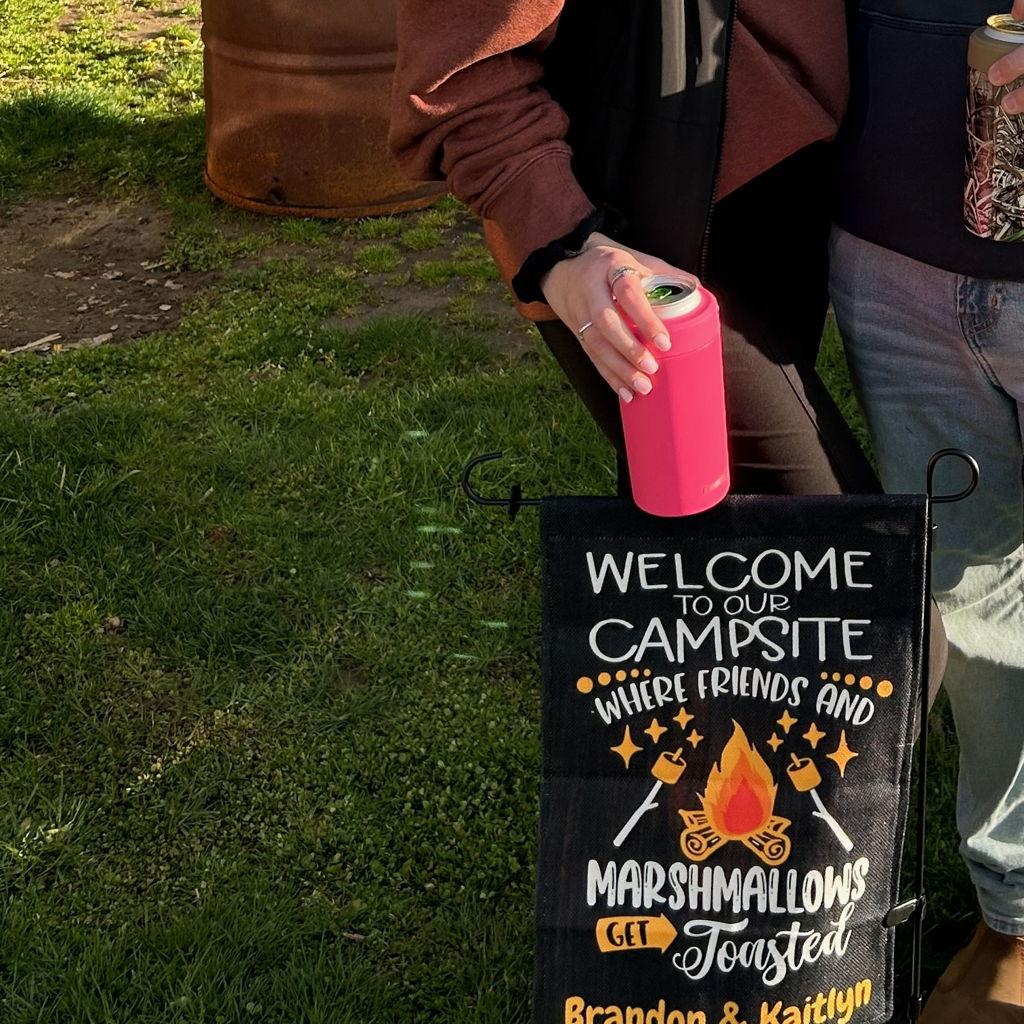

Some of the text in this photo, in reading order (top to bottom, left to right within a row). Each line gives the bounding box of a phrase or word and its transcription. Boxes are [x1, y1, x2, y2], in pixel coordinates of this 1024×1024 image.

[585, 546, 873, 594] WELCOME
[673, 593, 791, 616] TO OUR
[588, 615, 873, 664] CAMPSITE
[594, 665, 876, 726] WHERE FRIENDS AND
[586, 856, 870, 914] MARSHMALLOWS
[606, 902, 855, 987] GET Toasted
[564, 977, 873, 1024] Brandon & Kaitlyn
